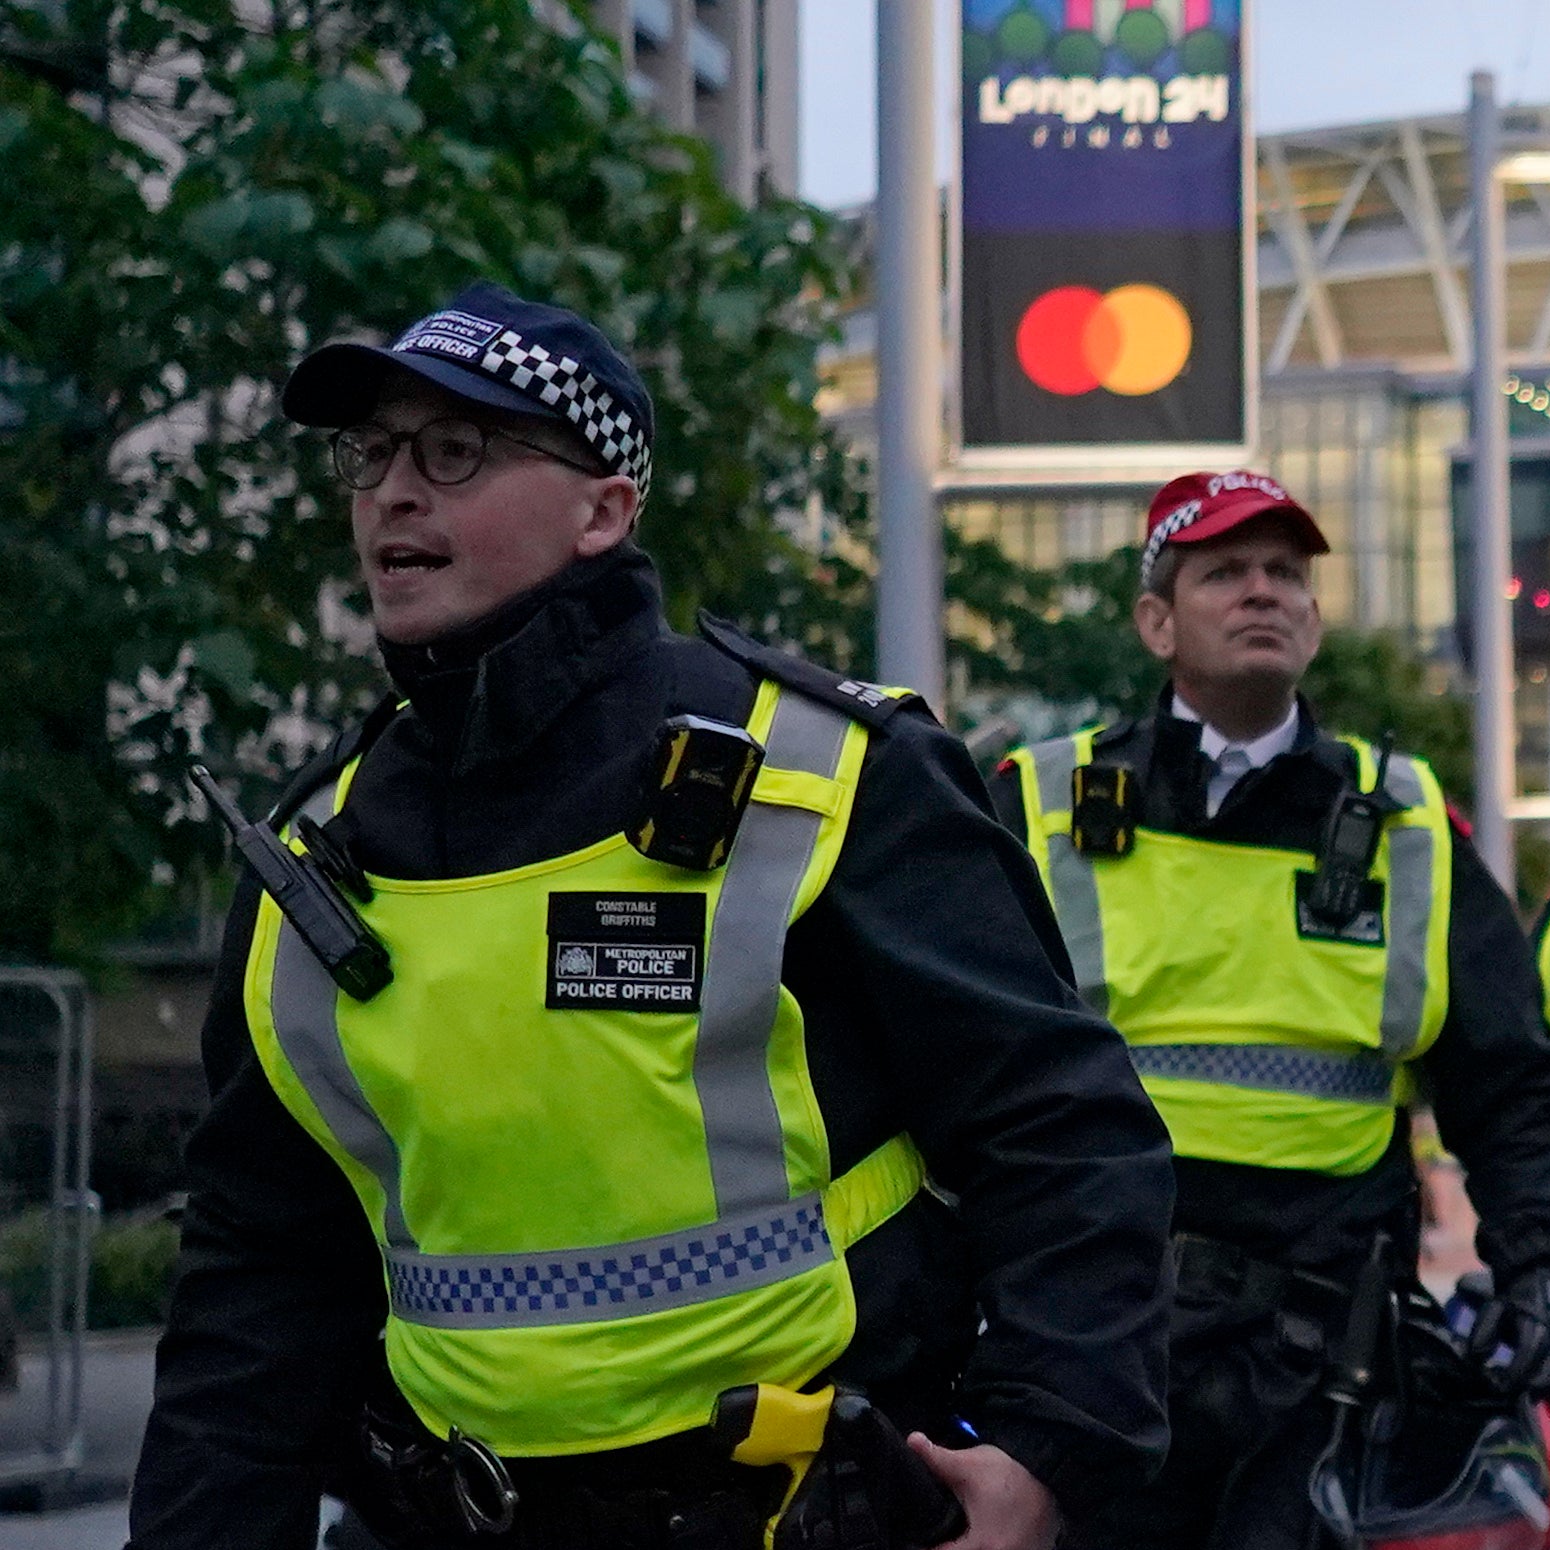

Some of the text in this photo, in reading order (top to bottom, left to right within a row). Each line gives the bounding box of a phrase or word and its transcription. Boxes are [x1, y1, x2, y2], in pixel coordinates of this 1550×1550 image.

[1161, 74, 1230, 124] 24
[417, 334, 478, 358] OFFICER
[595, 900, 657, 913] CONSTABLE
[604, 948, 687, 961] METROPOLITAN
[616, 959, 675, 975] POLICE
[556, 982, 693, 1000] POLICE OFFICER
